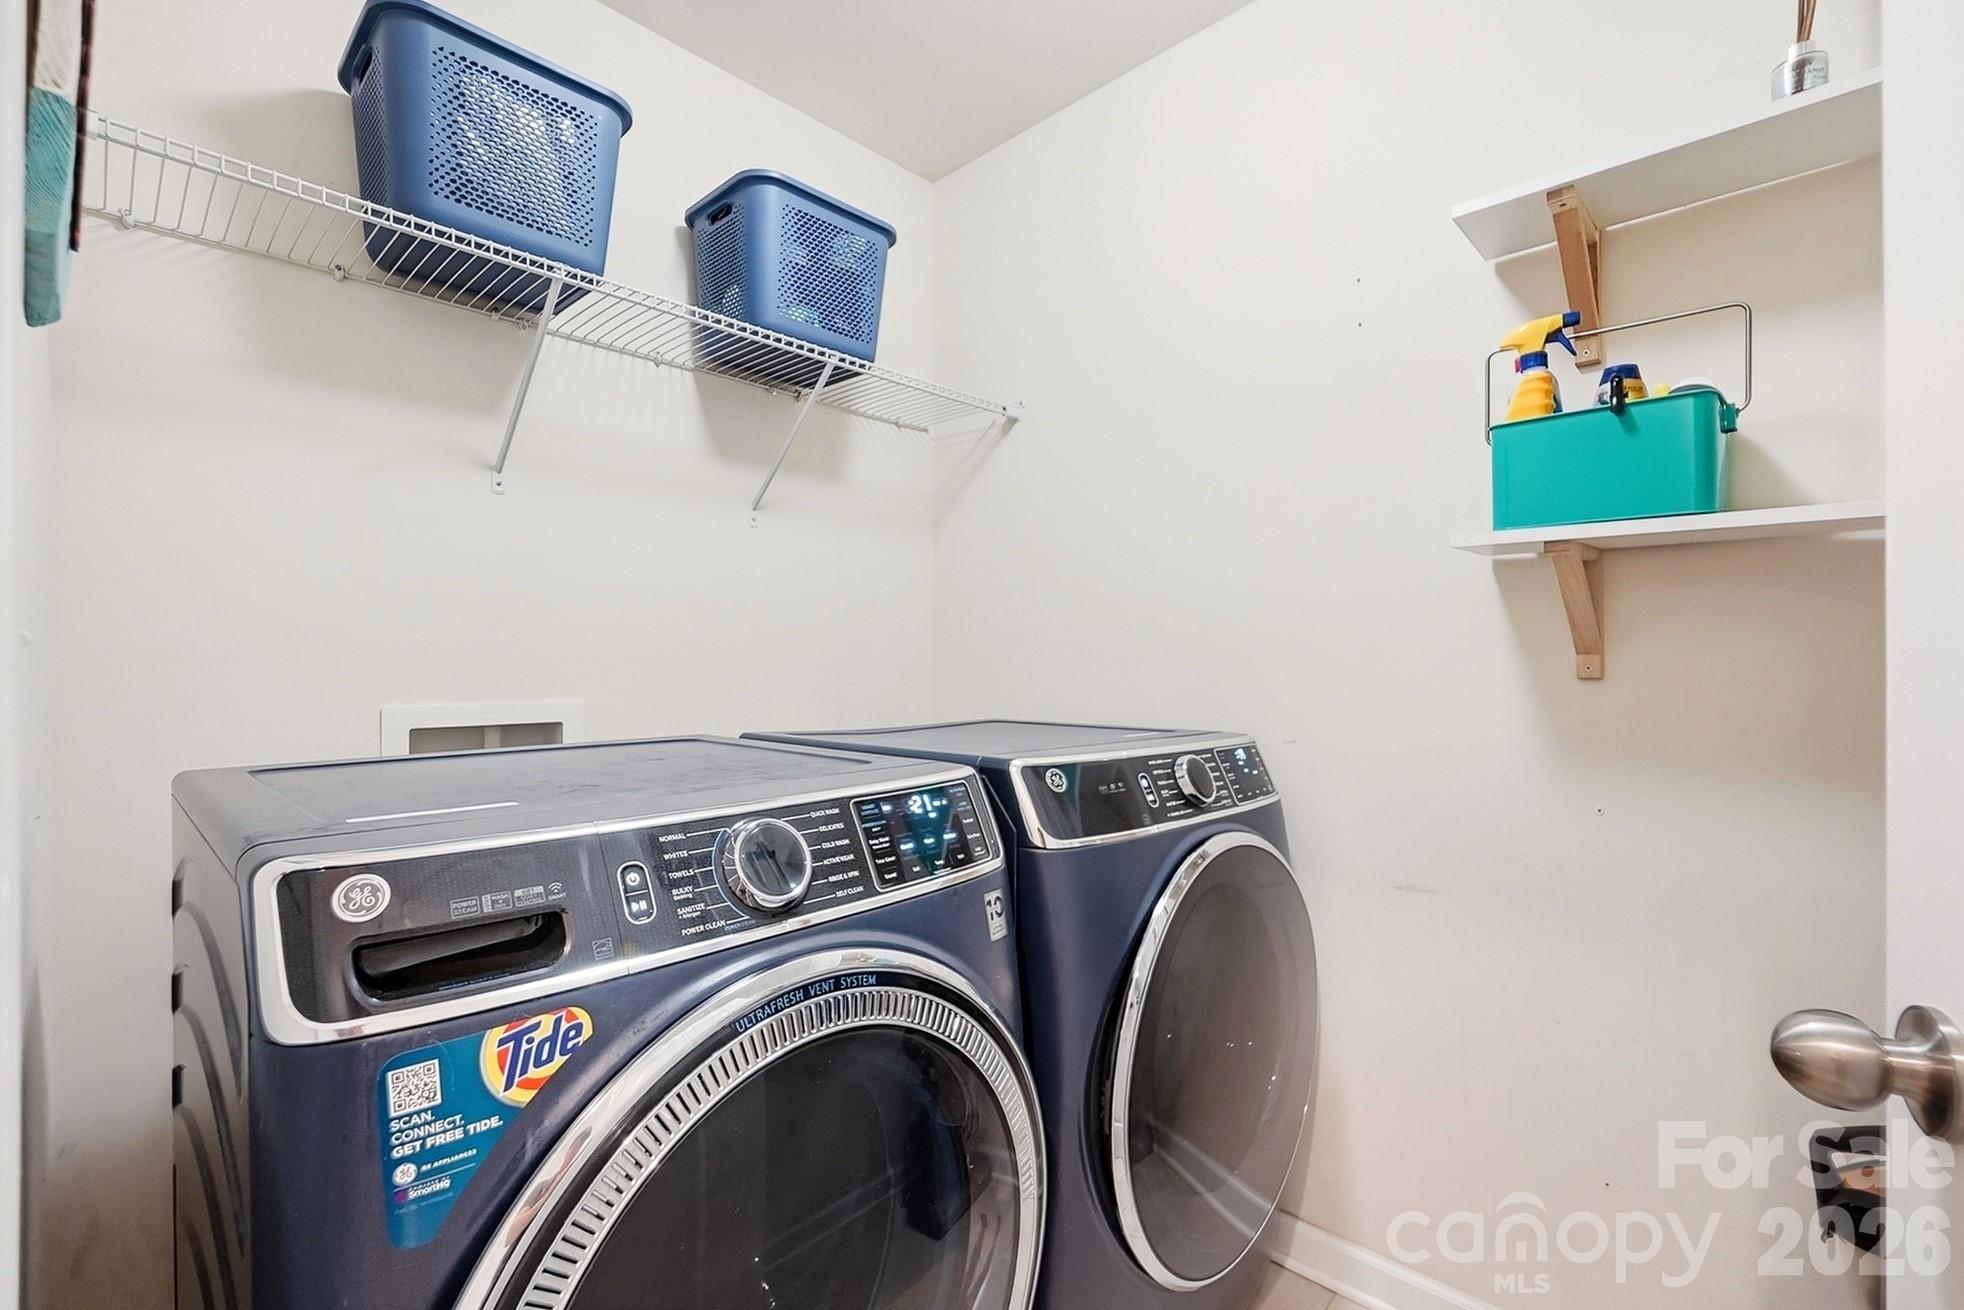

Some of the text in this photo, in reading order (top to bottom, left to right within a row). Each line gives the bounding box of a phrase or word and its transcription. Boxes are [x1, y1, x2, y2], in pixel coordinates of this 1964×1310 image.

[819, 822, 844, 832] DELICATES
[659, 833, 686, 842] NORMAL
[822, 841, 835, 849] COLD
[663, 851, 688, 860] WHITES
[823, 854, 855, 865] ACTIVEWEAR
[668, 869, 694, 879] TOWELS
[672, 886, 693, 895] BULKY
[847, 886, 864, 894] CLEAN
[453, 905, 478, 916] STEAM
[677, 903, 705, 915] SANITIZE
[681, 920, 726, 936] POWER CLEAN
[735, 974, 877, 1033] ULTRAFRESH VENT SYSTEM
[497, 1013, 584, 1093] Tide
[389, 1110, 435, 1132] SCAN.
[390, 1114, 464, 1145] CONNECT.
[391, 1115, 503, 1159] GET FREE TIDE.
